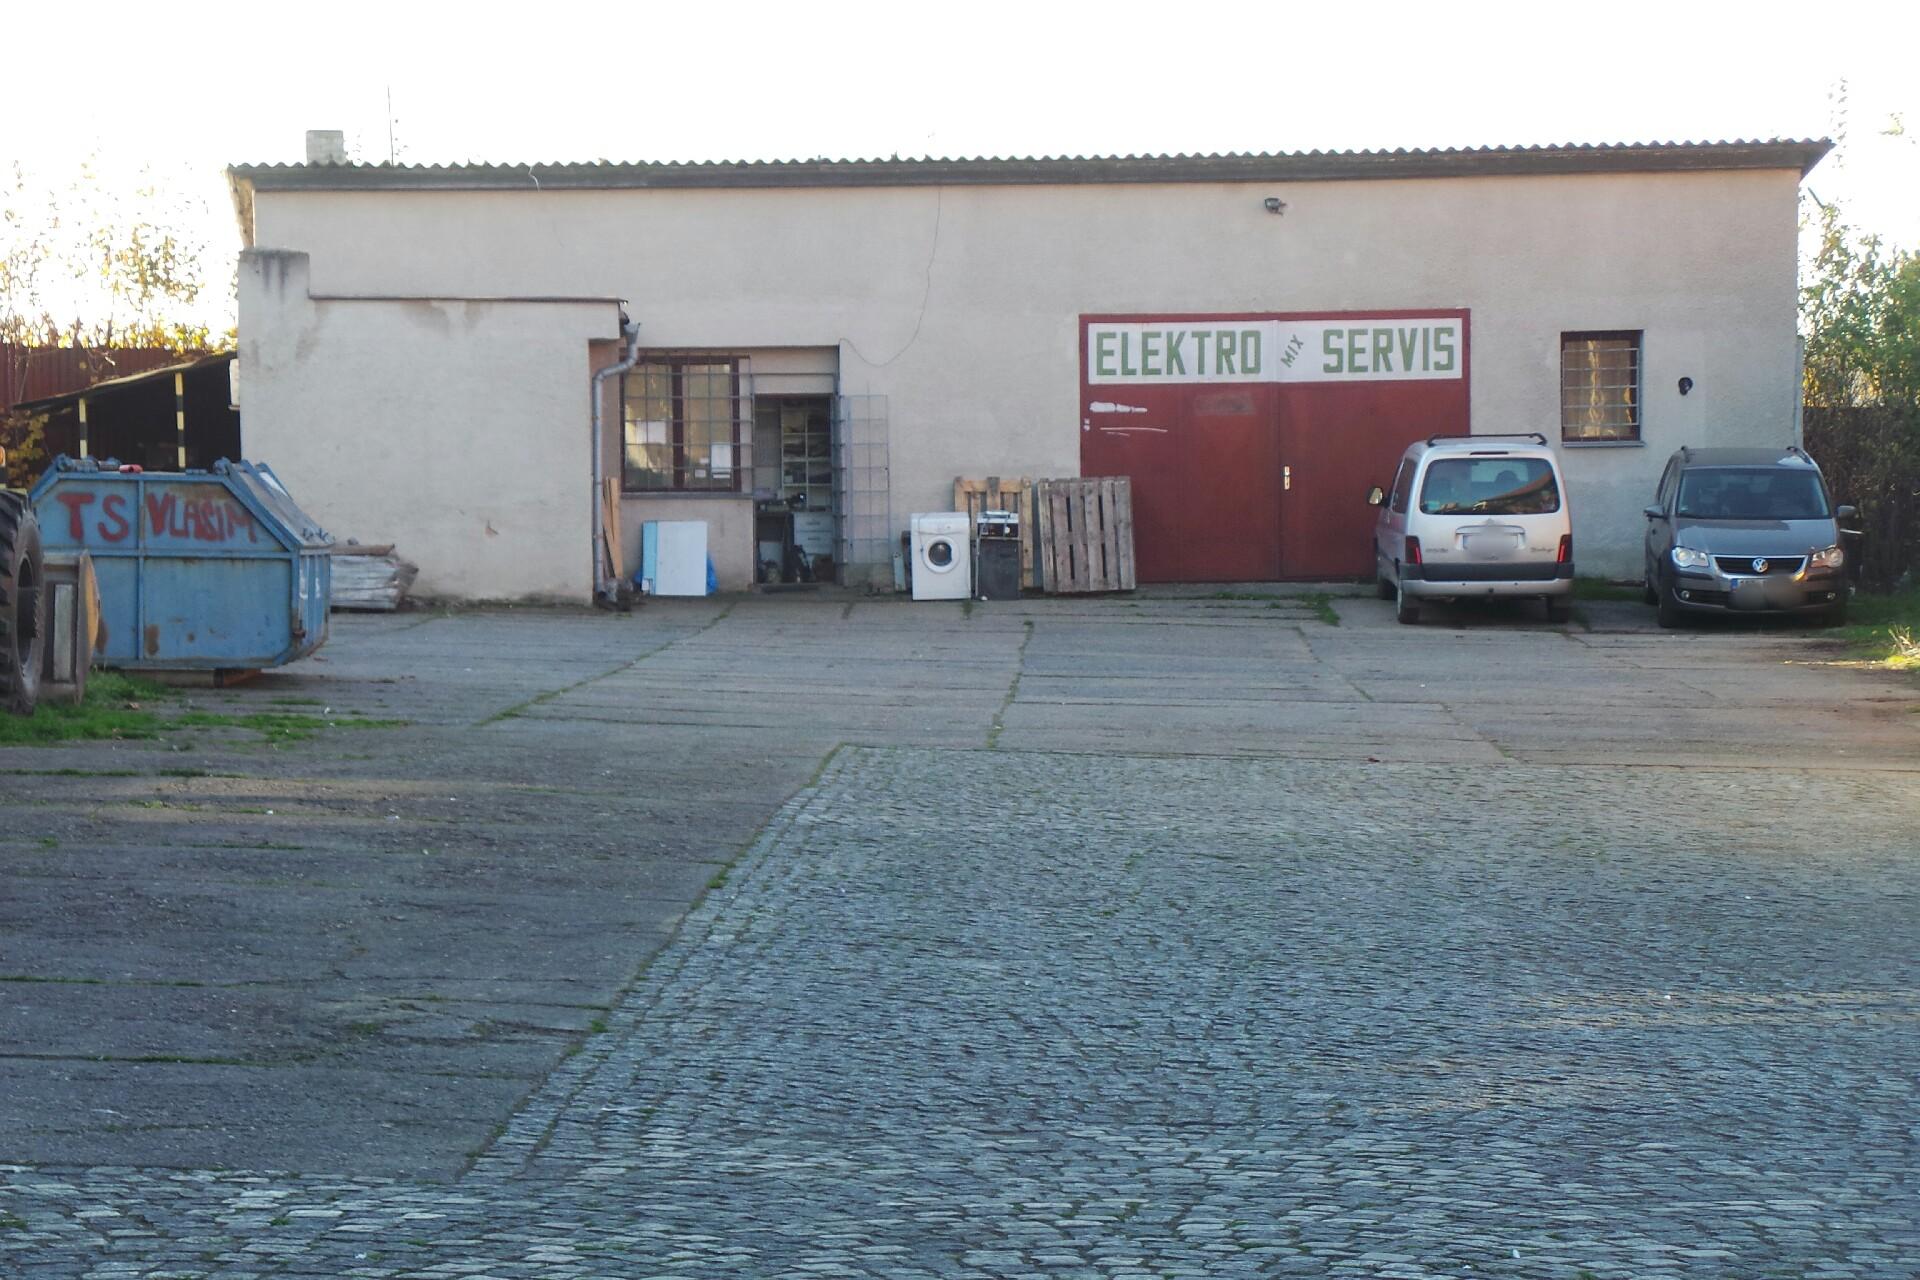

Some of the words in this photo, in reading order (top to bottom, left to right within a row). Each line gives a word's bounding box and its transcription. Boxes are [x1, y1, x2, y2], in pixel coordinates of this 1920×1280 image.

[1096, 330, 1262, 376] ELEKTRO
[1280, 334, 1304, 368] MIX
[1323, 327, 1454, 373] SERVIS
[56, 492, 129, 543] TS
